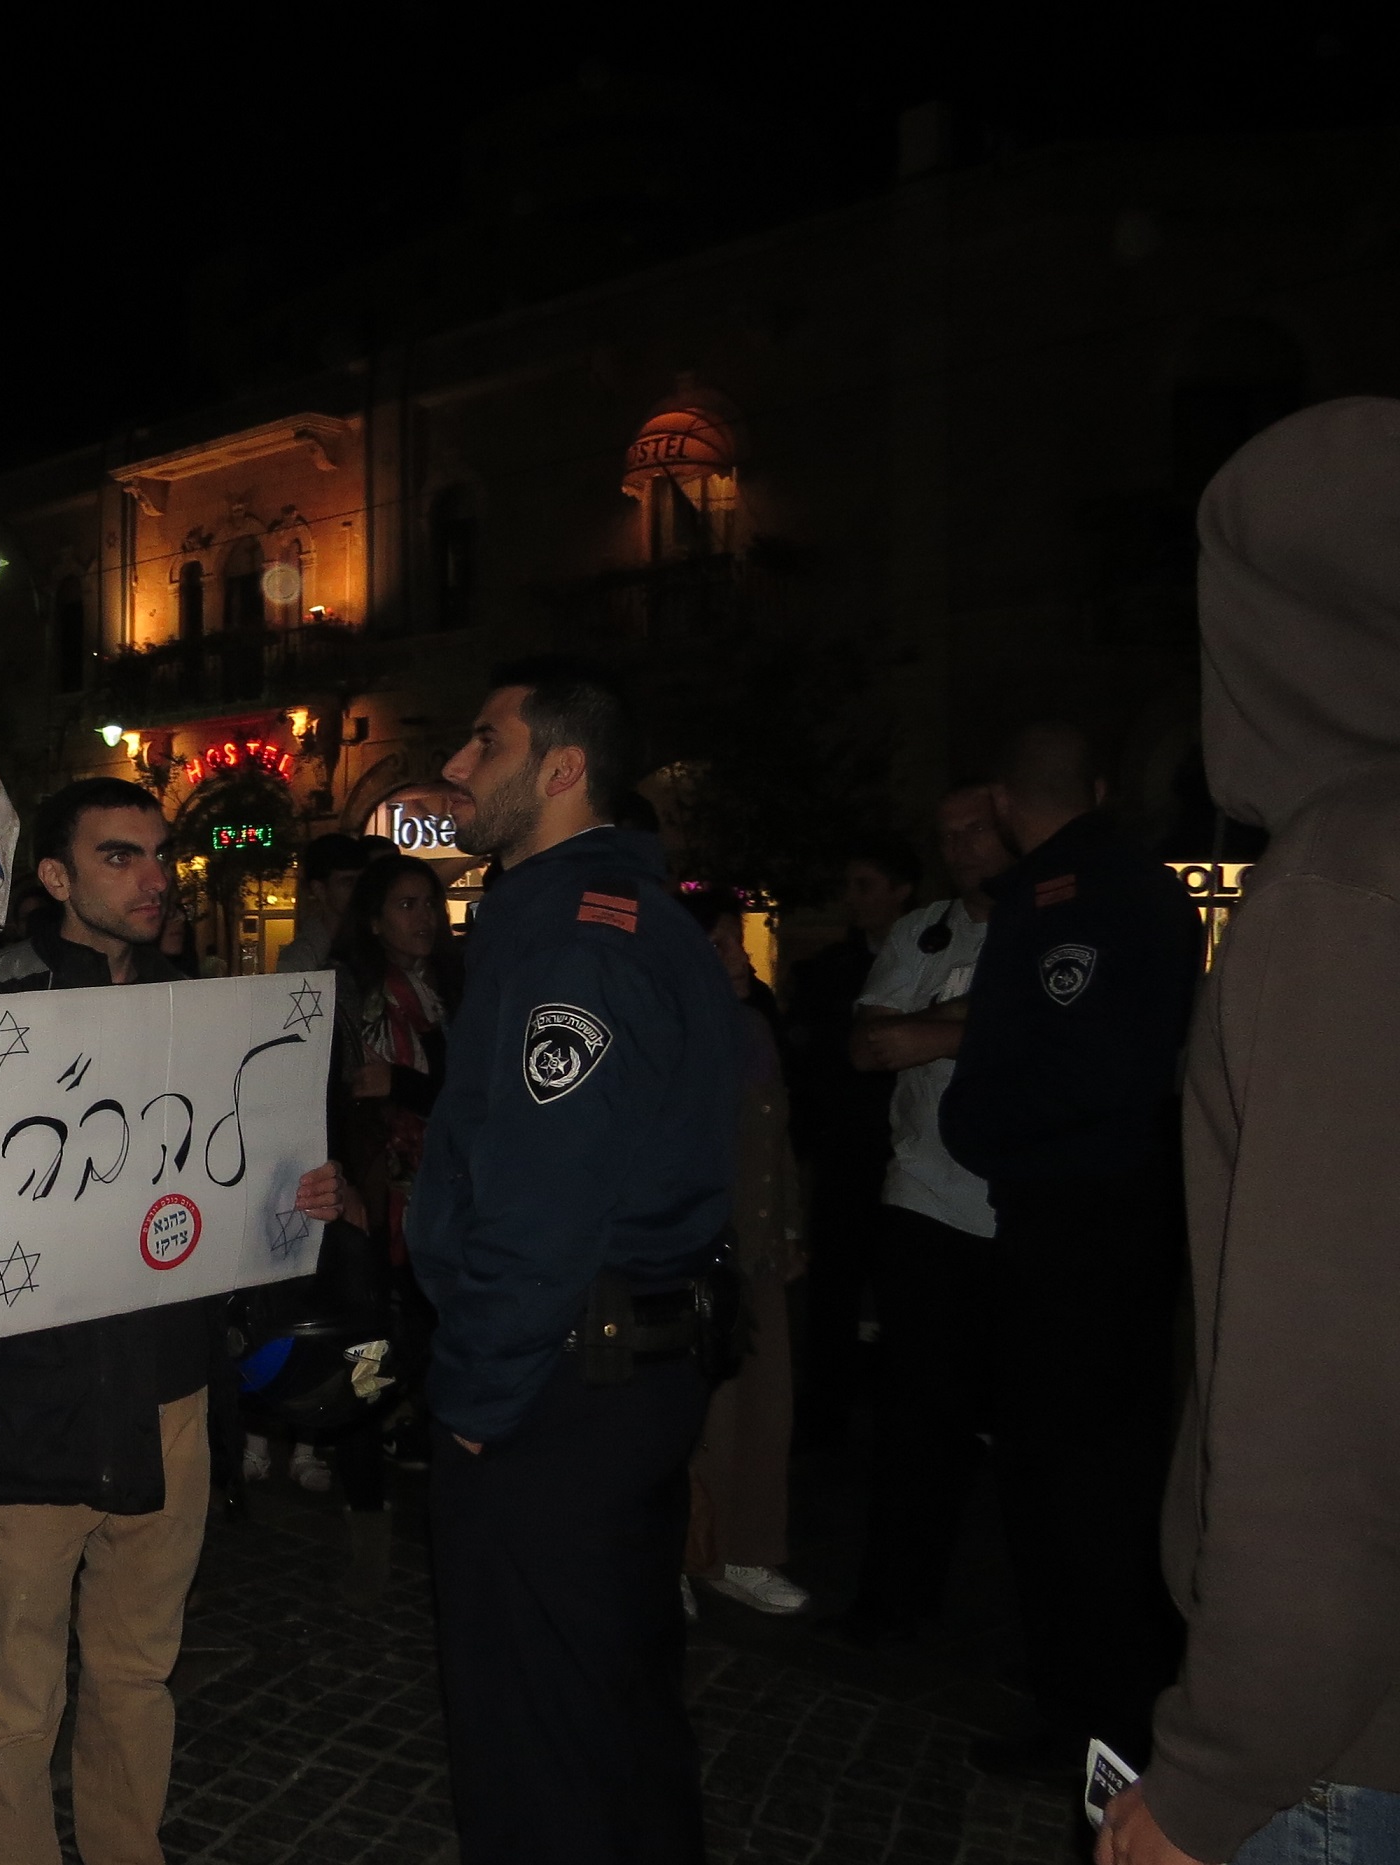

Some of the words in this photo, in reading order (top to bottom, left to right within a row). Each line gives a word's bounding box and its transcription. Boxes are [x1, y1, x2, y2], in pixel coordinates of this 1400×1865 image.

[630, 436, 688, 463] STEL
[185, 741, 292, 783] HOSTEL
[153, 1210, 187, 1234] כהנא
[156, 1230, 188, 1256] צדק!
